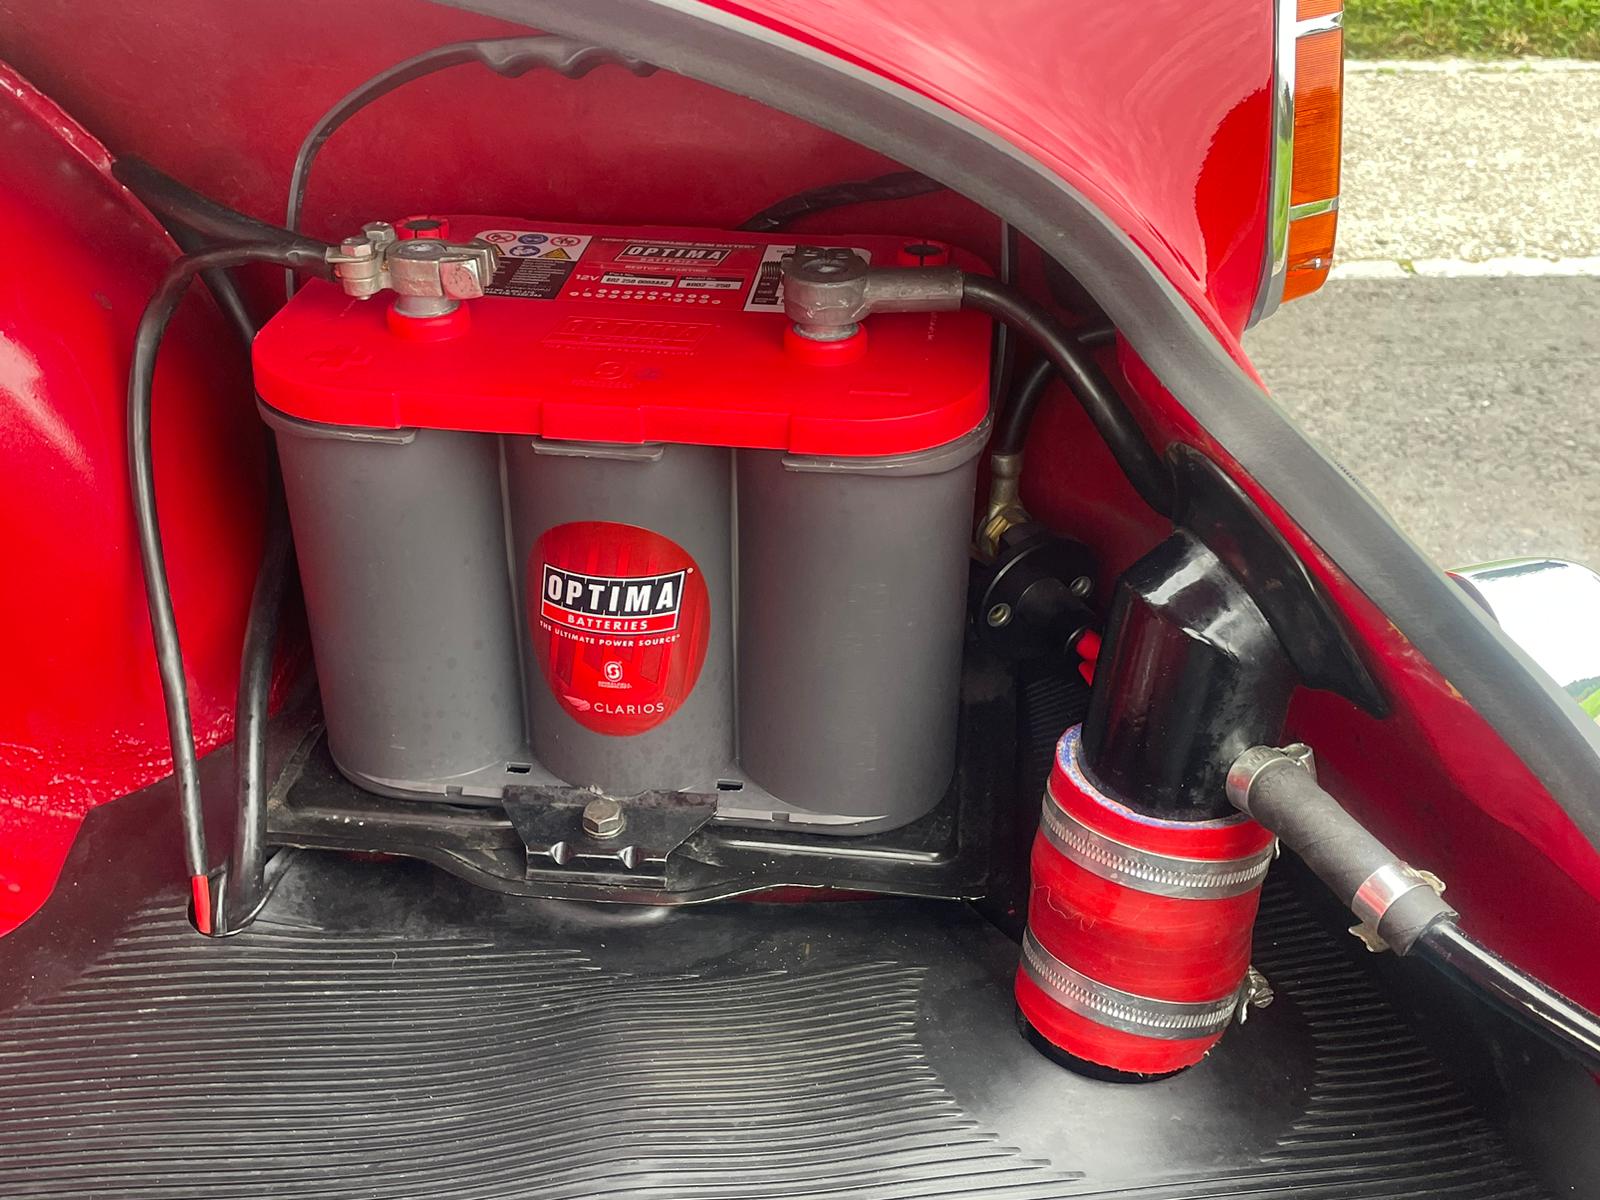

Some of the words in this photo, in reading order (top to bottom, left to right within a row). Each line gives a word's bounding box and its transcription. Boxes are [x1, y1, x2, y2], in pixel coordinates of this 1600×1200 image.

[627, 246, 722, 261] OPTIMA
[575, 274, 600, 282] 12V
[547, 574, 674, 612] OPTIMA
[567, 614, 648, 631] BATTERIES
[539, 620, 552, 632] THE
[554, 628, 595, 645] ULTIMATE
[598, 639, 634, 647] POWER
[593, 702, 665, 715] CLARIOS
